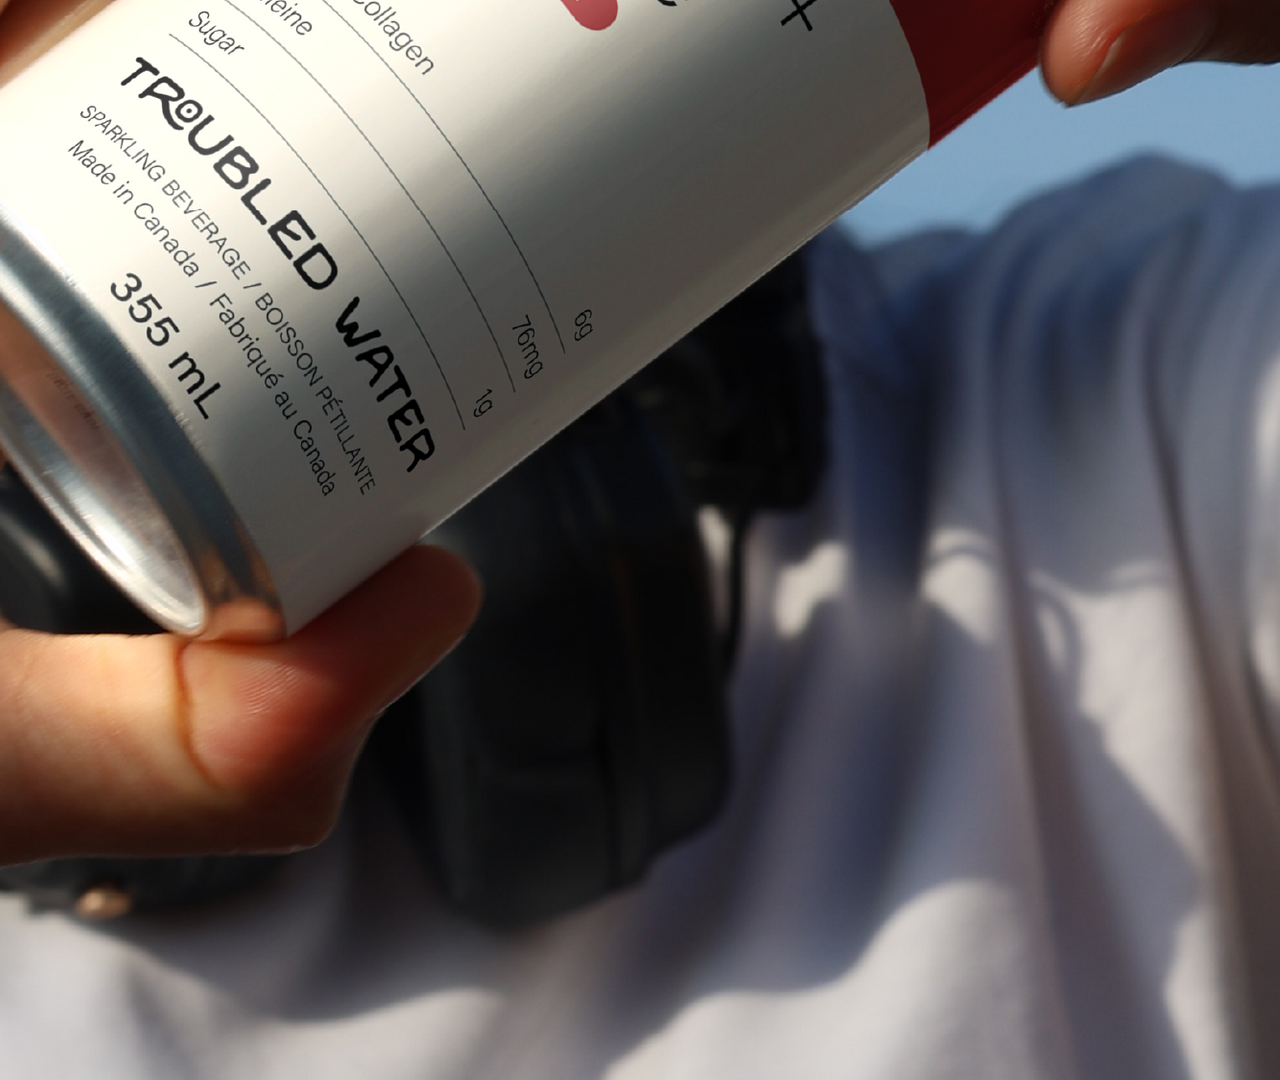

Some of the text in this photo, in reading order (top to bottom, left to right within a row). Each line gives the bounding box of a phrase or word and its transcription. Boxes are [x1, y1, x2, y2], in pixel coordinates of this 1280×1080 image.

[188, 11, 245, 56] Sugar
[67, 139, 116, 185] Made
[113, 181, 134, 205] in
[133, 202, 199, 277] Canada
[209, 292, 285, 390] Fabriqué
[273, 390, 298, 421] au
[293, 419, 336, 497] Canada
[80, 105, 166, 182] SPARKLING
[161, 179, 251, 280] BEVERAGE
[255, 292, 323, 387] BOISSON
[315, 386, 376, 496] PÉTILLANTE
[120, 57, 436, 472] TROUBLED WATER
[110, 272, 221, 420] 355 mL
[511, 314, 544, 380] 76mg
[573, 308, 594, 342] 6g
[472, 388, 493, 419] 1g
